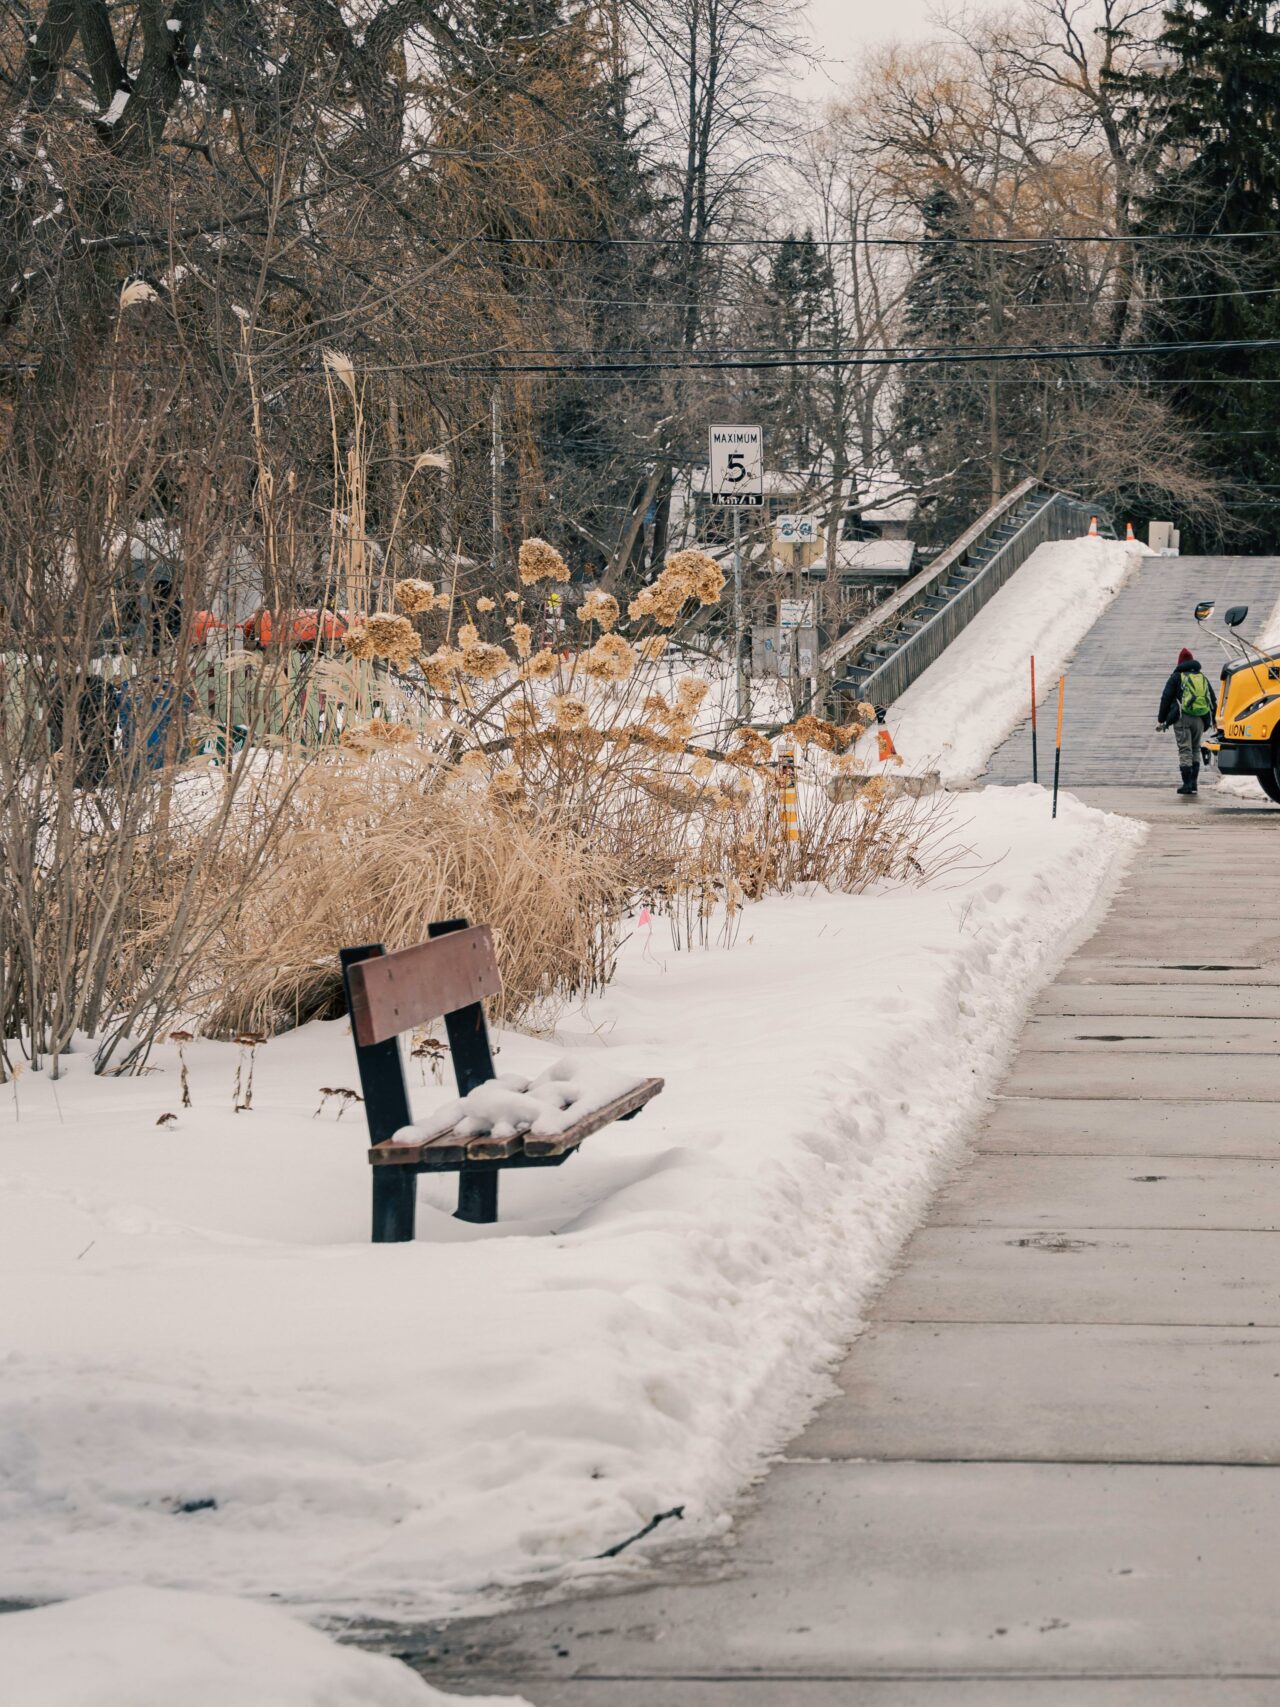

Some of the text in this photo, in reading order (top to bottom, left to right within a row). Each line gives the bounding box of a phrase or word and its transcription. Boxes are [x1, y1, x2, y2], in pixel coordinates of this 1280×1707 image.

[713, 433, 757, 444] MAXIMUM
[727, 453, 746, 483] 5
[719, 493, 757, 505] km/h
